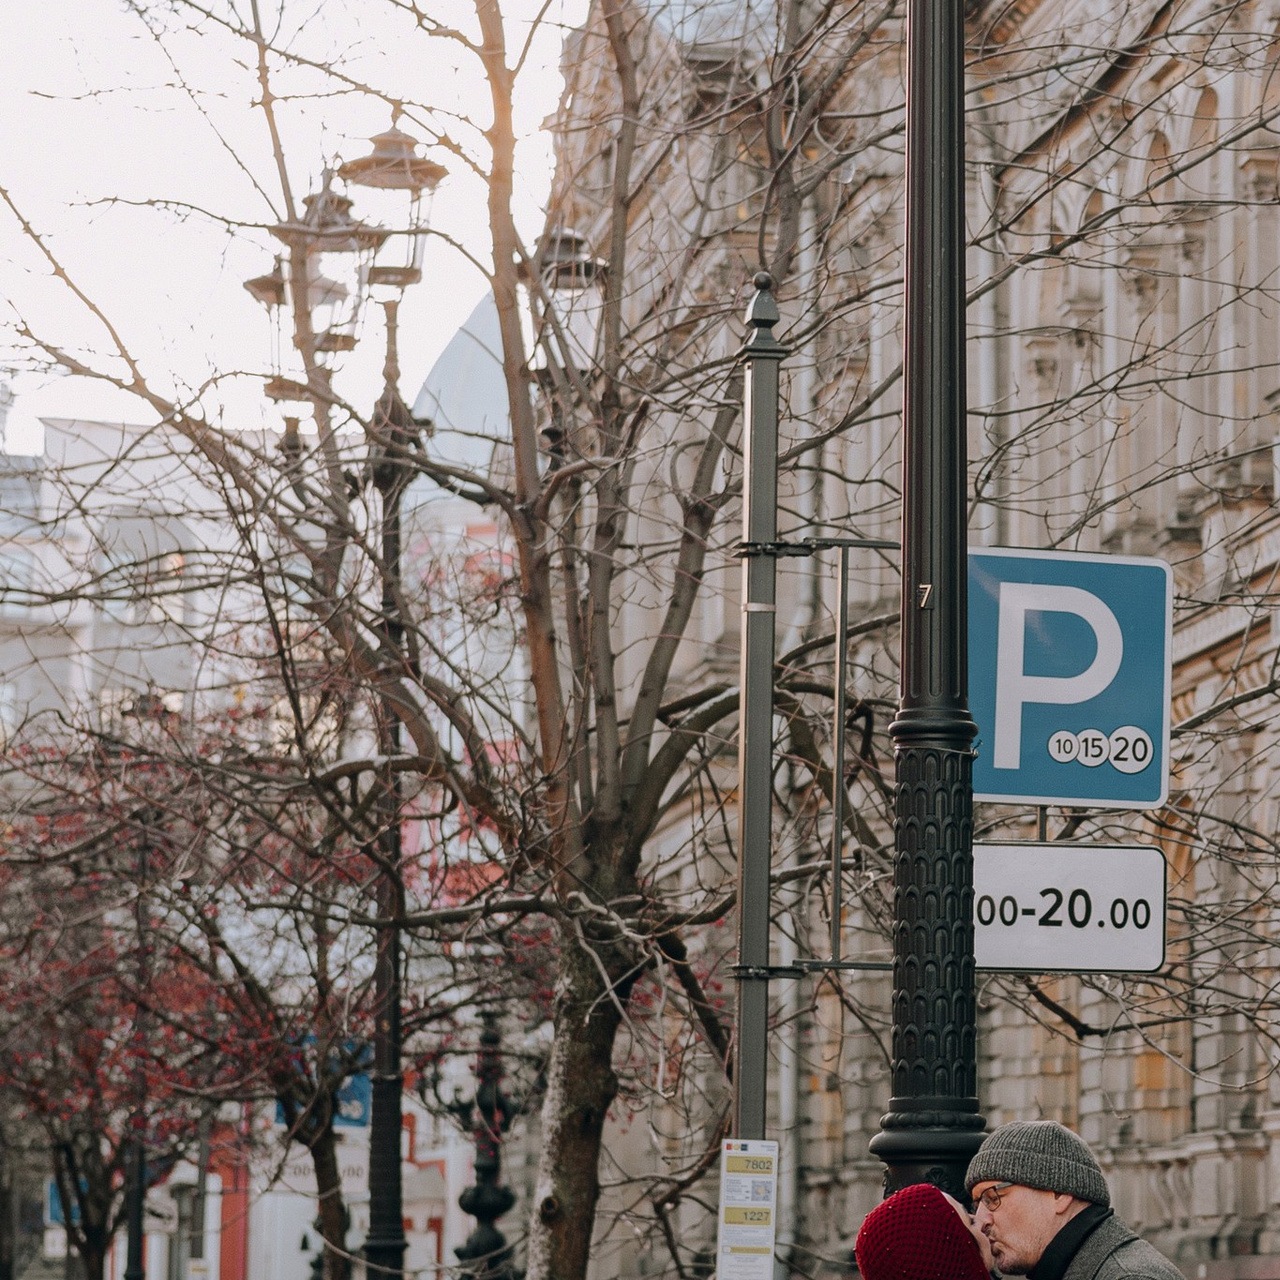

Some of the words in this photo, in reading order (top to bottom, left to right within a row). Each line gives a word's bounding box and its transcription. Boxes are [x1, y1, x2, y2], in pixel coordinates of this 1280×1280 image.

[918, 584, 932, 608] 7
[993, 581, 1124, 770] P
[1055, 738, 1073, 755] 10
[1081, 737, 1103, 758] 15
[1113, 736, 1148, 762] 20
[745, 1159, 773, 1170] 7802
[743, 1211, 770, 1221] 1227
